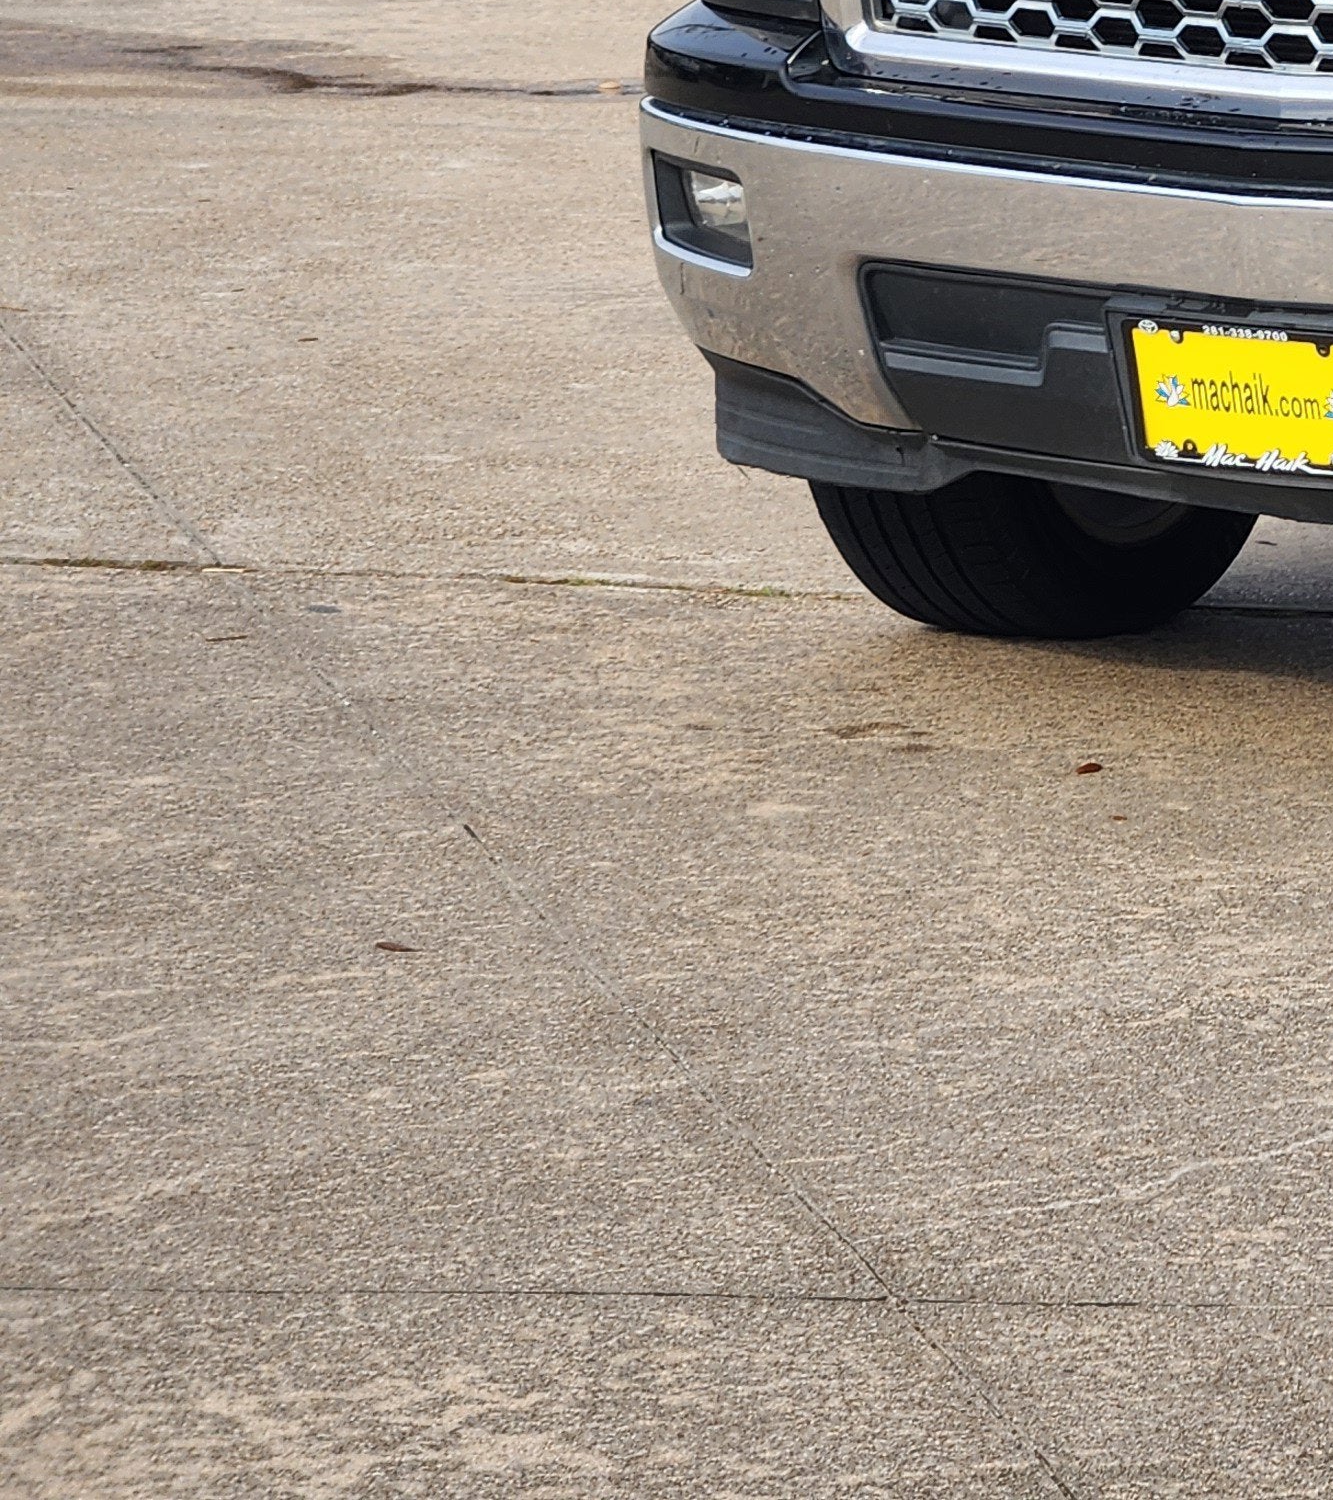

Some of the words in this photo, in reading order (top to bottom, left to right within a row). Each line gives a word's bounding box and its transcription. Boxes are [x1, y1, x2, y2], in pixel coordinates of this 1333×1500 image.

[1190, 370, 1323, 420] machaik.com
[1202, 444, 1252, 468] Mac
[1251, 448, 1312, 472] Haik
